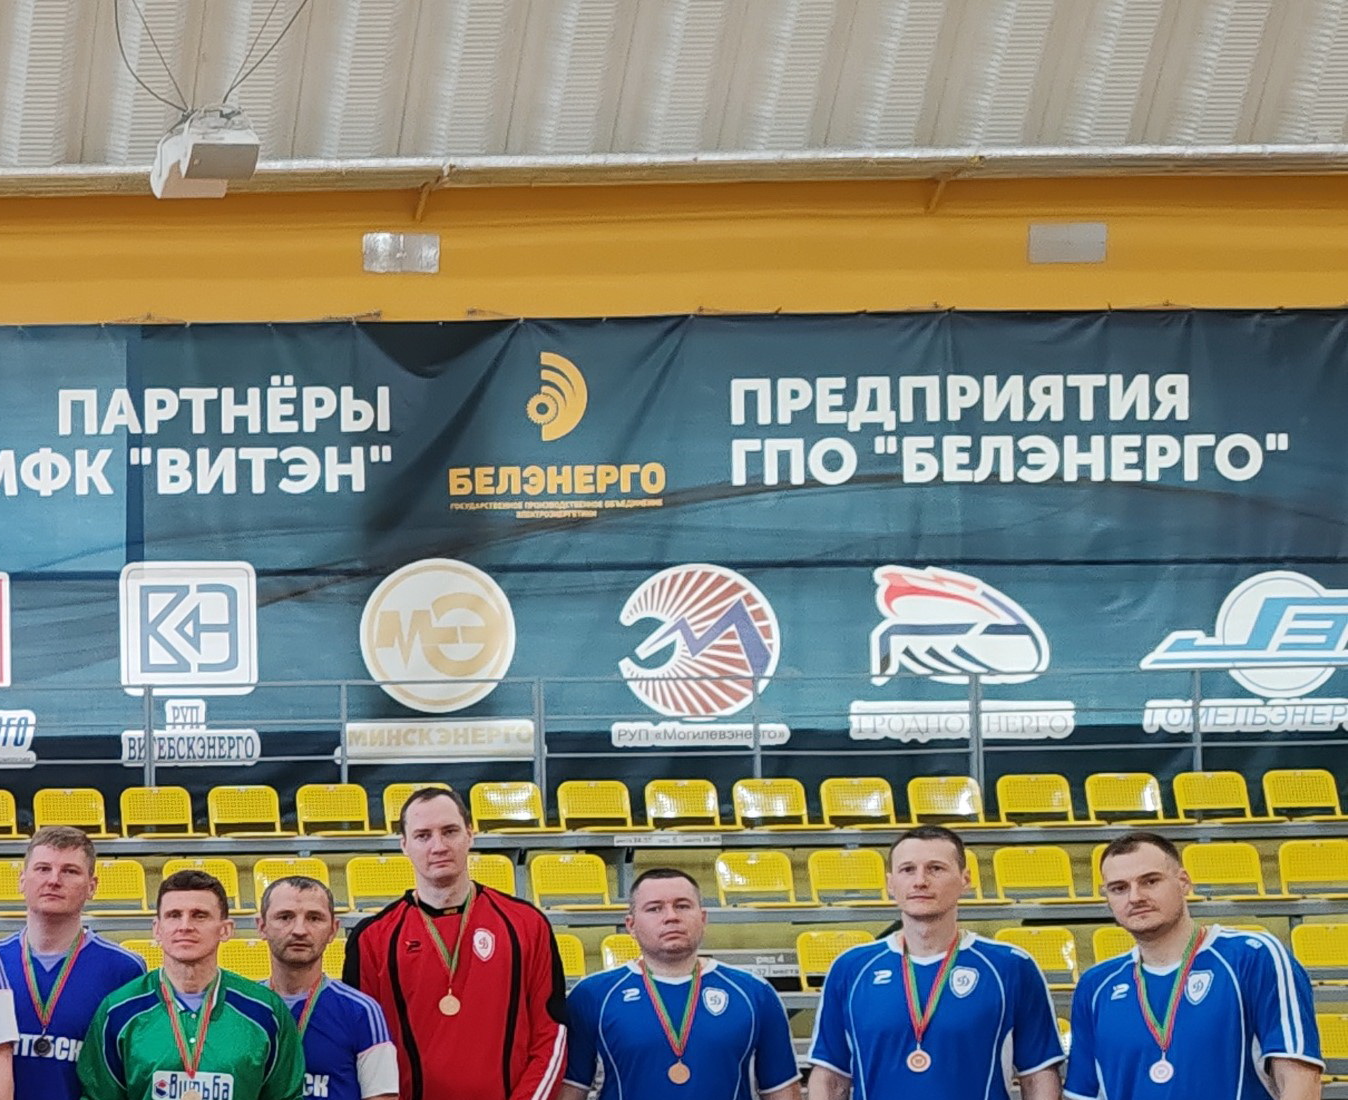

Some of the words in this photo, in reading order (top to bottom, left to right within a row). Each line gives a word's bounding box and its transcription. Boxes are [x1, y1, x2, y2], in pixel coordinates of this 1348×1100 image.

[57, 374, 391, 436] ПАРТНЁРЫ
[730, 373, 1191, 432] ПРЕДПРИЯТИЯ
[130, 445, 391, 494] "ВИТЭН"
[731, 438, 857, 485] ГПО
[875, 433, 1288, 483] "БЕЛЭНЕРГО"
[449, 462, 666, 496] БЕЛЭНЕРГО
[172, 706, 200, 731] РУП
[855, 714, 1069, 736] ГРОДНОНЕРГО
[128, 736, 255, 761] ВИЕБСКЭНЕРГО
[347, 727, 534, 747] МИНСКЭНЕРГО
[617, 729, 650, 742] РУП
